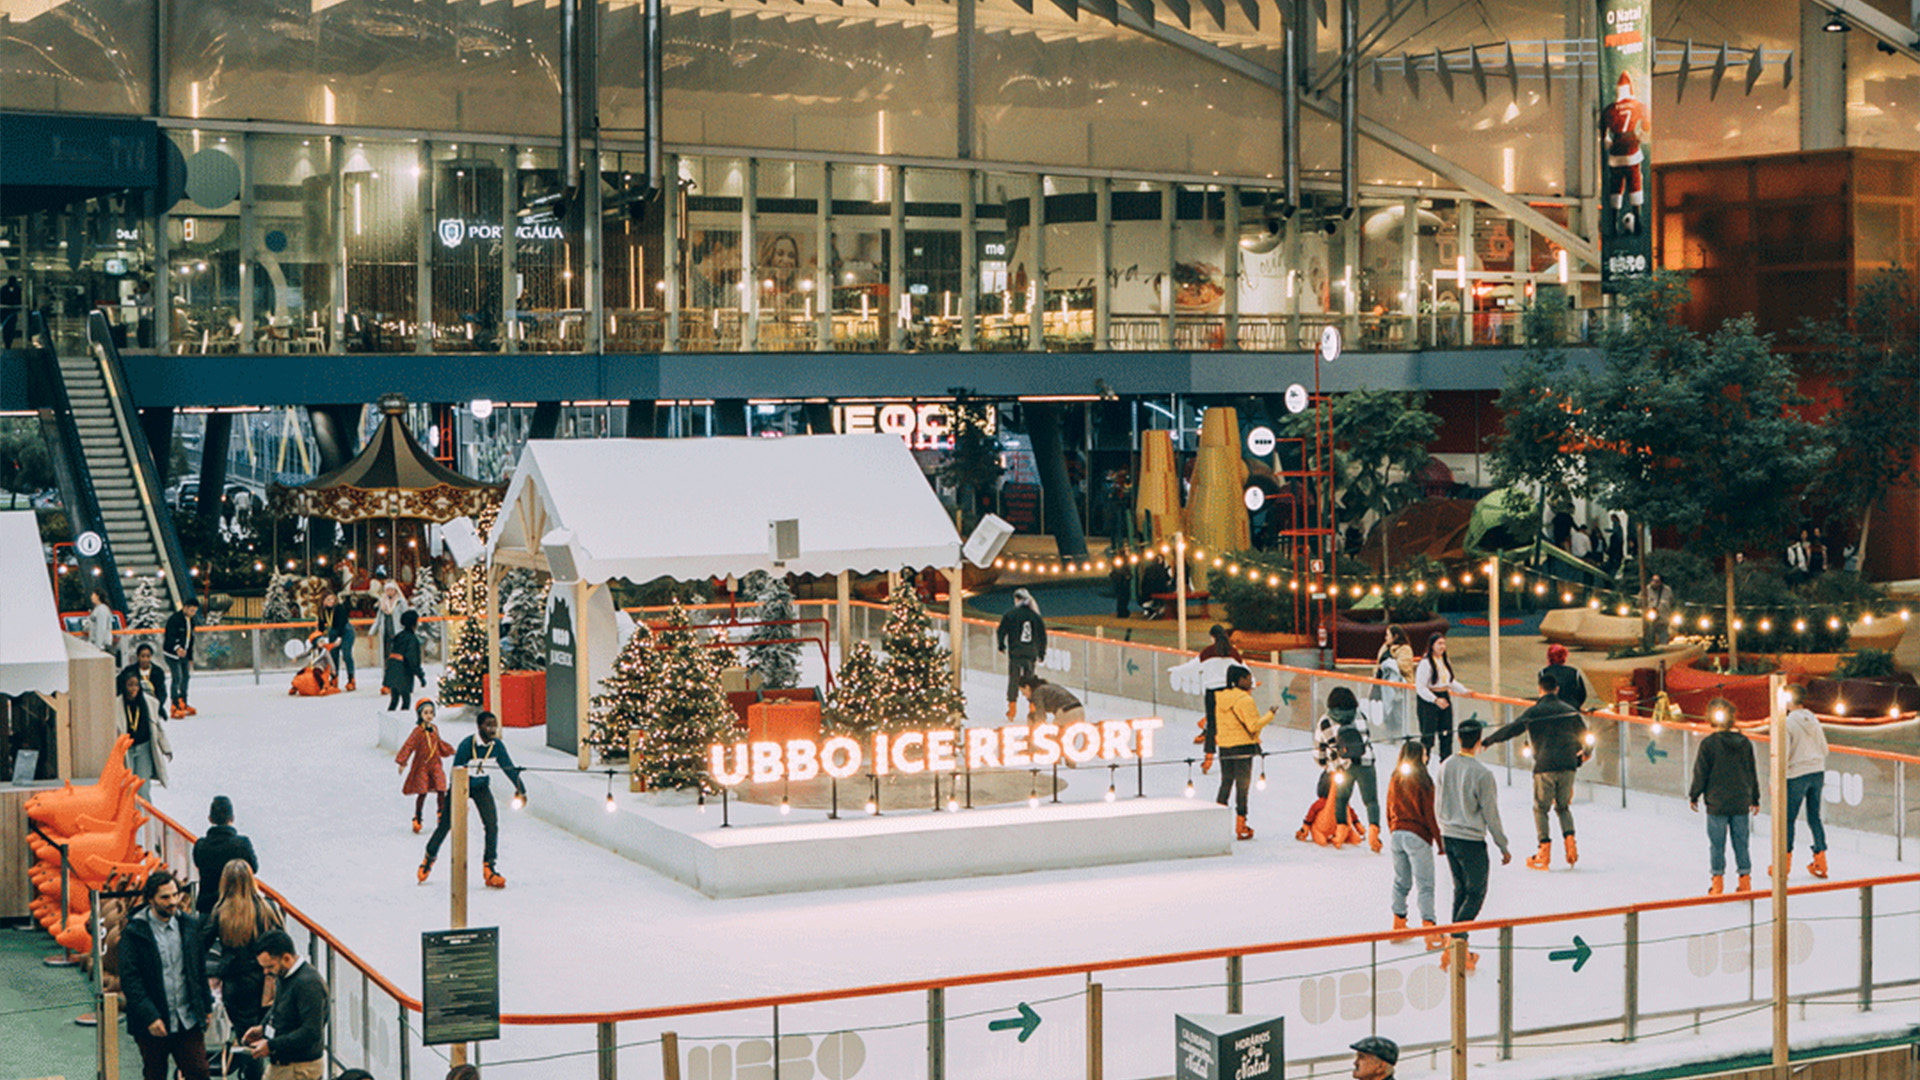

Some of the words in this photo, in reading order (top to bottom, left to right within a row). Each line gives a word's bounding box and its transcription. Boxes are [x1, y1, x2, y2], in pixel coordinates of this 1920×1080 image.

[1606, 10, 1615, 25] O
[1616, 5, 1642, 22] Natal
[1619, 109, 1632, 132] 7
[985, 243, 1006, 255] me
[709, 735, 863, 786] UBBO
[871, 729, 957, 776] ICE
[965, 718, 1163, 769] RESORT
[1235, 1031, 1270, 1051] HORÁRIOS
[1235, 1053, 1270, 1080] Natal
